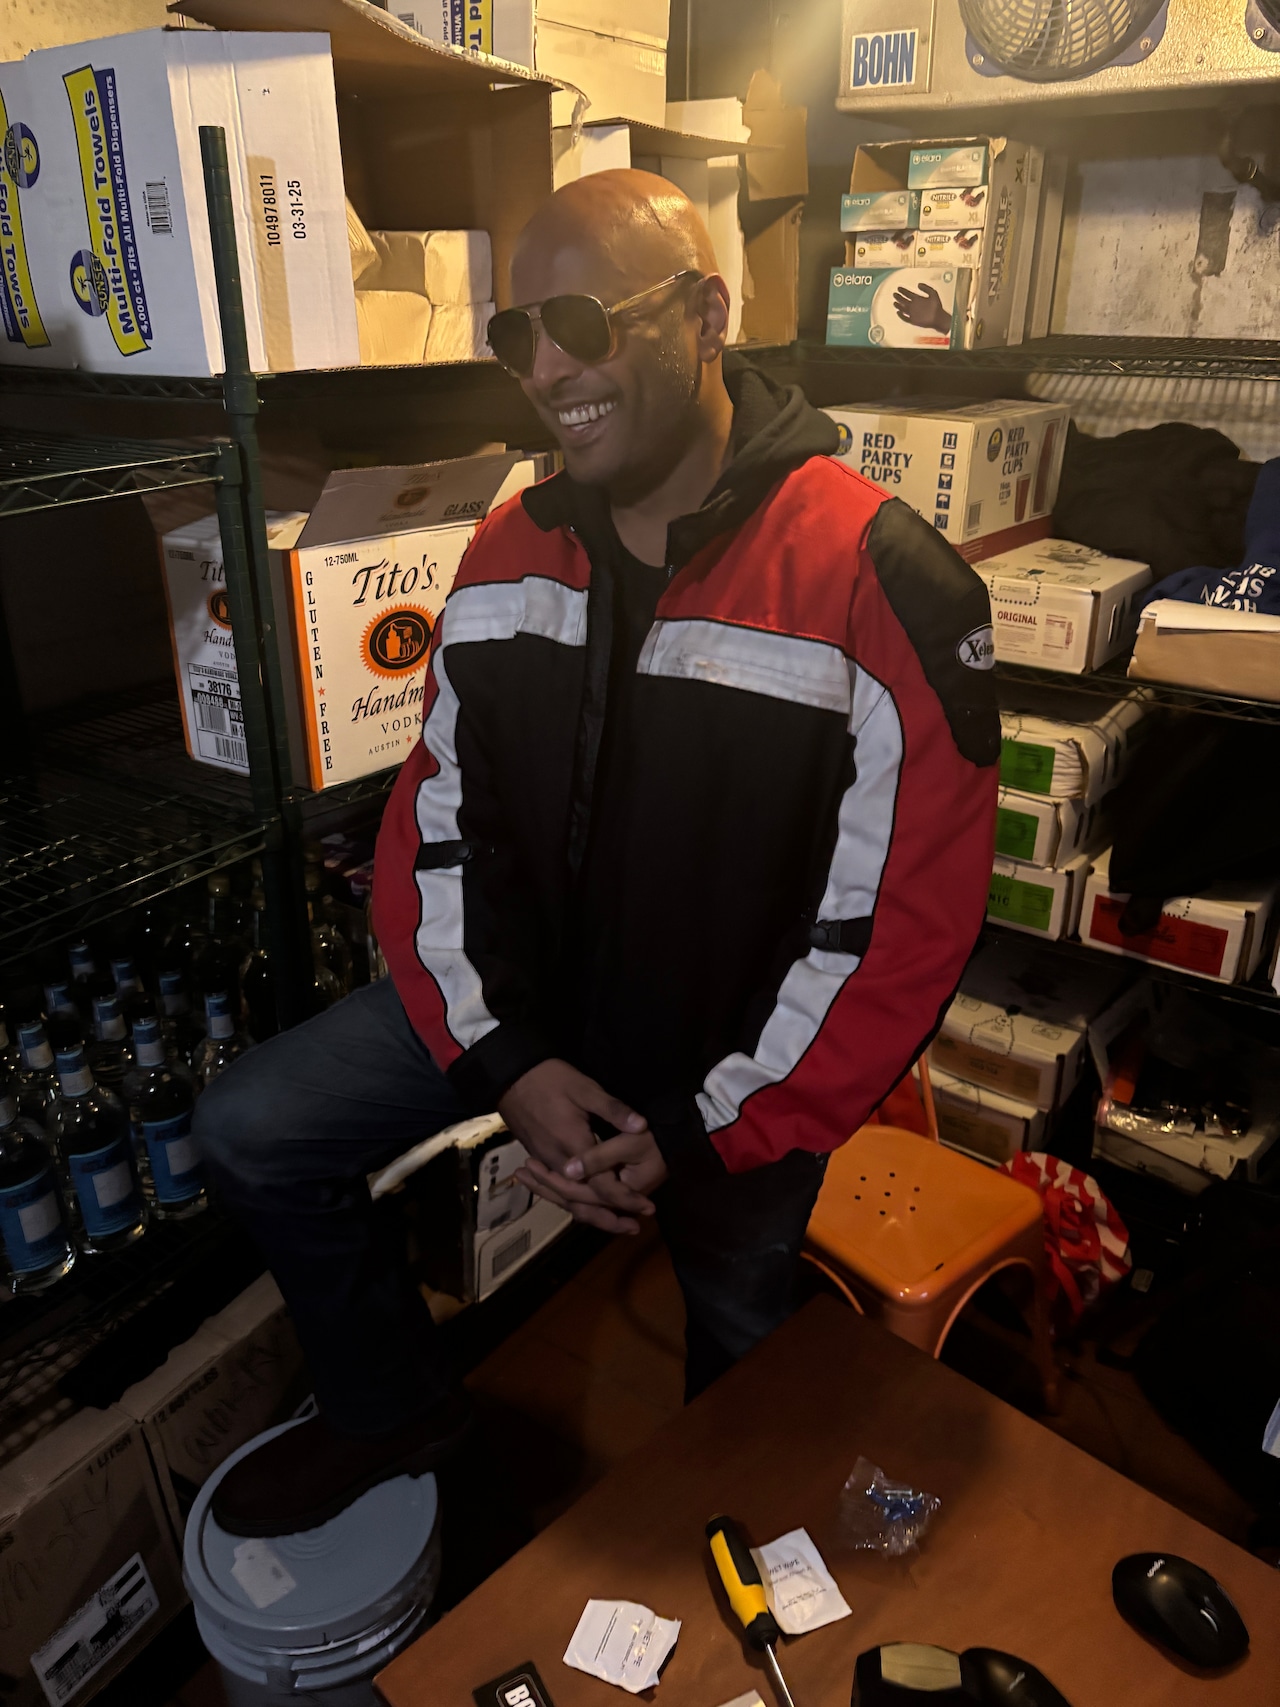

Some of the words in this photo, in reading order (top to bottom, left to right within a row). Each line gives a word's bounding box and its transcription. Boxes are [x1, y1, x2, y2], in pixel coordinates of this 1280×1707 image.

[853, 31, 916, 88] BOHN
[105, 75, 121, 152] Dispensers
[85, 90, 109, 190] Towels
[113, 154, 130, 220] Multi-Fold
[931, 193, 955, 201] NITRILE
[259, 174, 281, 247] 104978011
[288, 180, 307, 239] 03-31-25
[123, 225, 133, 243] All
[926, 235, 950, 243] NITRILE
[988, 197, 1008, 298] NITRILE
[98, 197, 135, 335] Multi-Fold
[127, 245, 138, 271] Fits
[5, 243, 31, 329] Towels
[91, 255, 109, 310] SUNSET
[134, 280, 142, 294] ct
[845, 274, 872, 285] elara
[136, 298, 149, 334] 4,000
[863, 432, 895, 449] RED
[1007, 426, 1025, 443] RED
[861, 449, 913, 468] PARTY
[1004, 441, 1030, 460] PARTY
[860, 465, 902, 484] CUPS
[1002, 458, 1024, 476] CUPS
[443, 500, 484, 516] GLASS
[324, 552, 359, 567] 12-750ML
[352, 553, 437, 605] Tito's
[997, 610, 1038, 625] ORIGINAL
[203, 628, 235, 647] Hand
[305, 571, 323, 679] GLUTEN
[319, 702, 333, 770] FREE
[351, 676, 424, 723] Handm
[381, 712, 422, 734] VODK
[368, 738, 401, 756] AUSTIN
